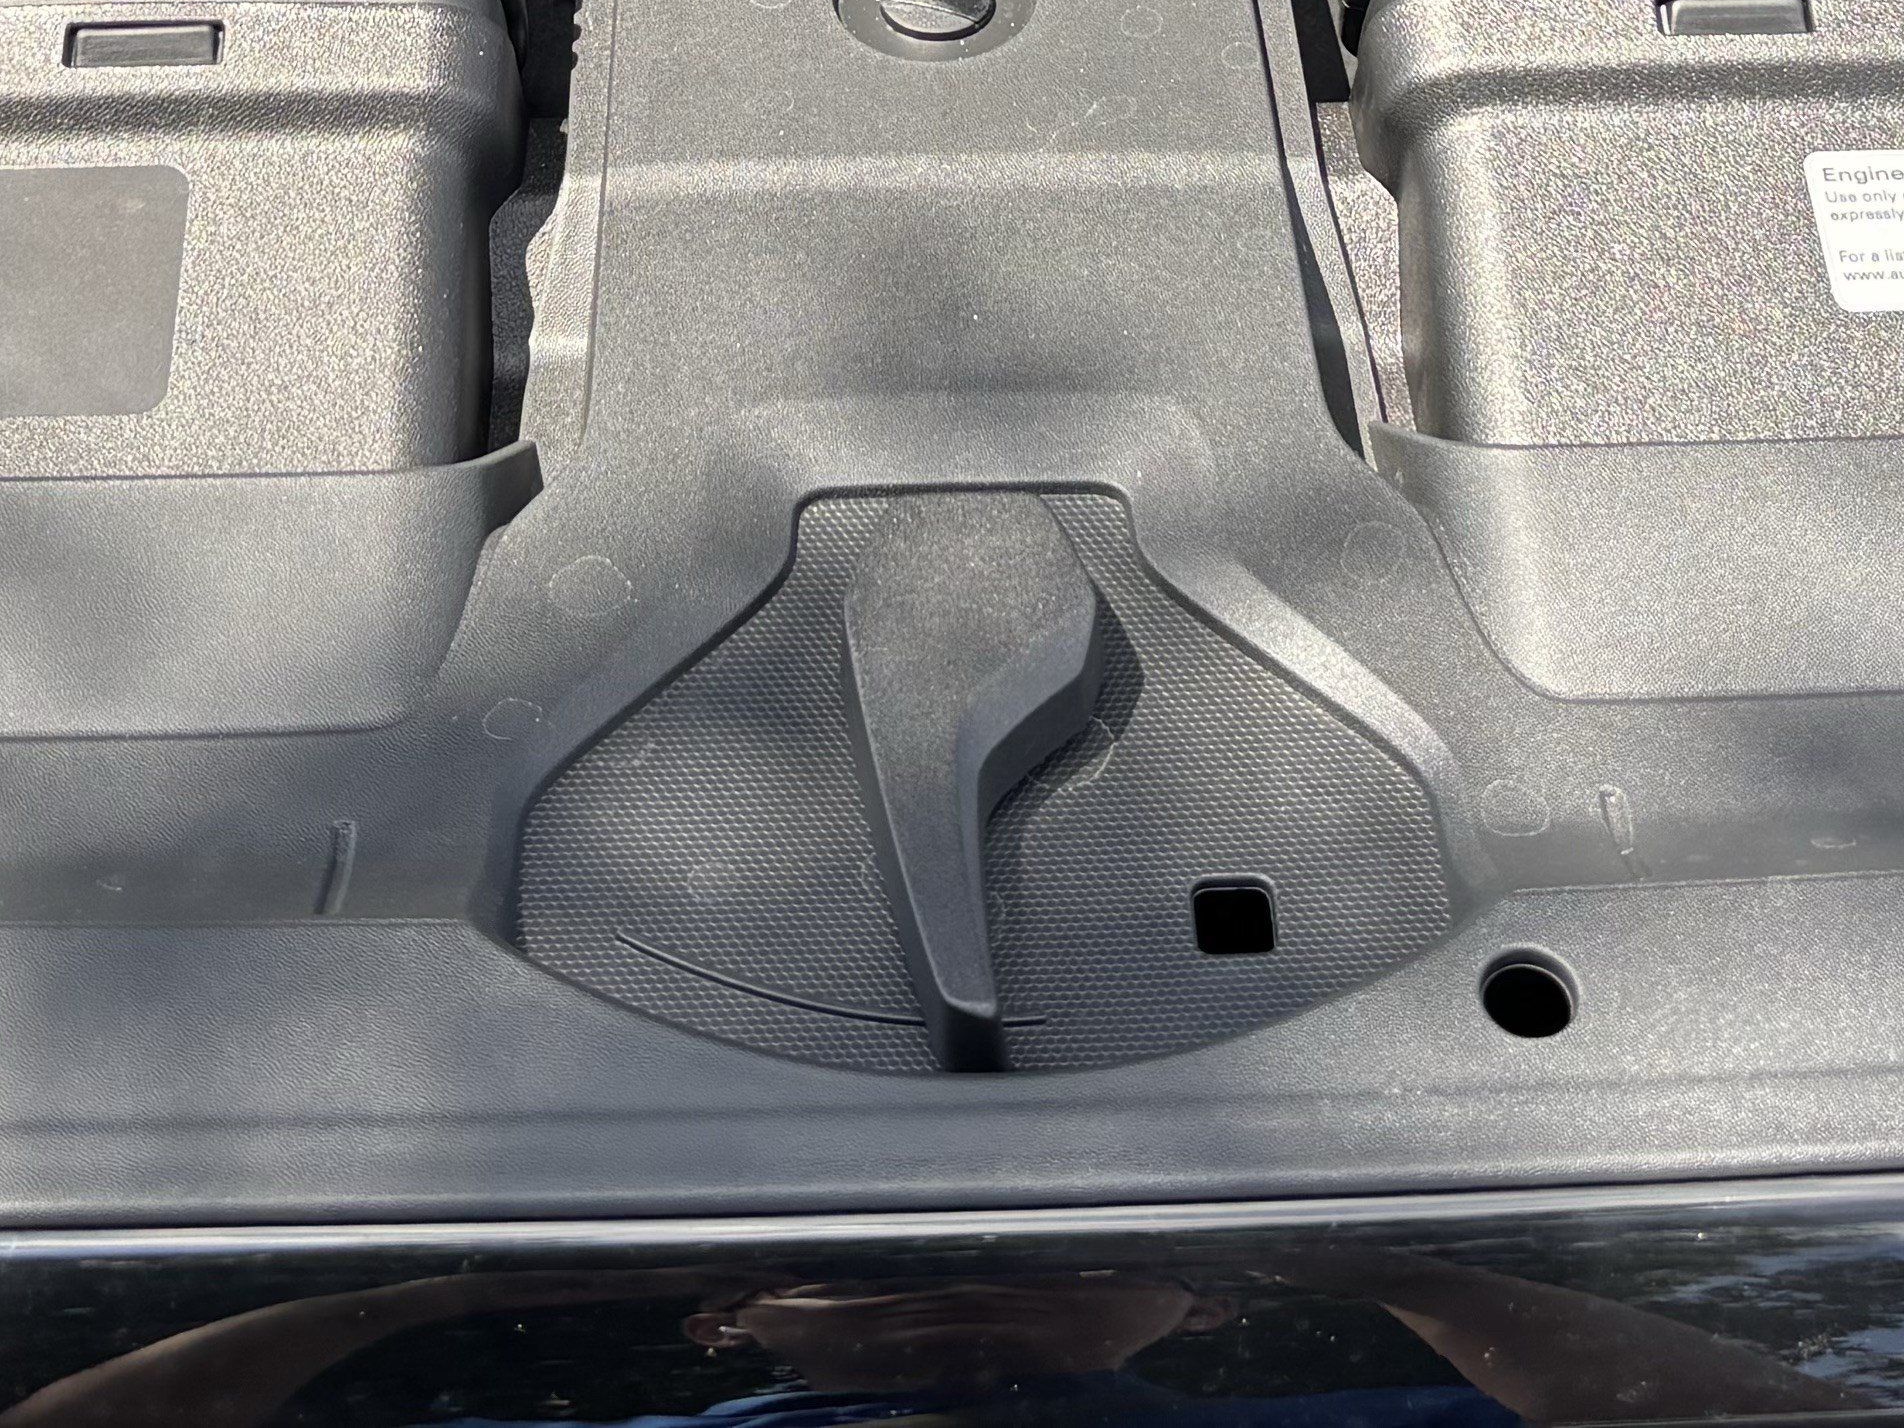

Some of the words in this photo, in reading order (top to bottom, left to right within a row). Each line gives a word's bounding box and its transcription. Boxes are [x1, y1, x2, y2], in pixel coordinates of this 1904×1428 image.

[1823, 166, 1904, 184] Engine
[1825, 192, 1857, 203] Use
[1863, 190, 1896, 203] only
[1831, 209, 1904, 222] expressly
[1839, 250, 1864, 262] For
[1872, 253, 1879, 262] a
